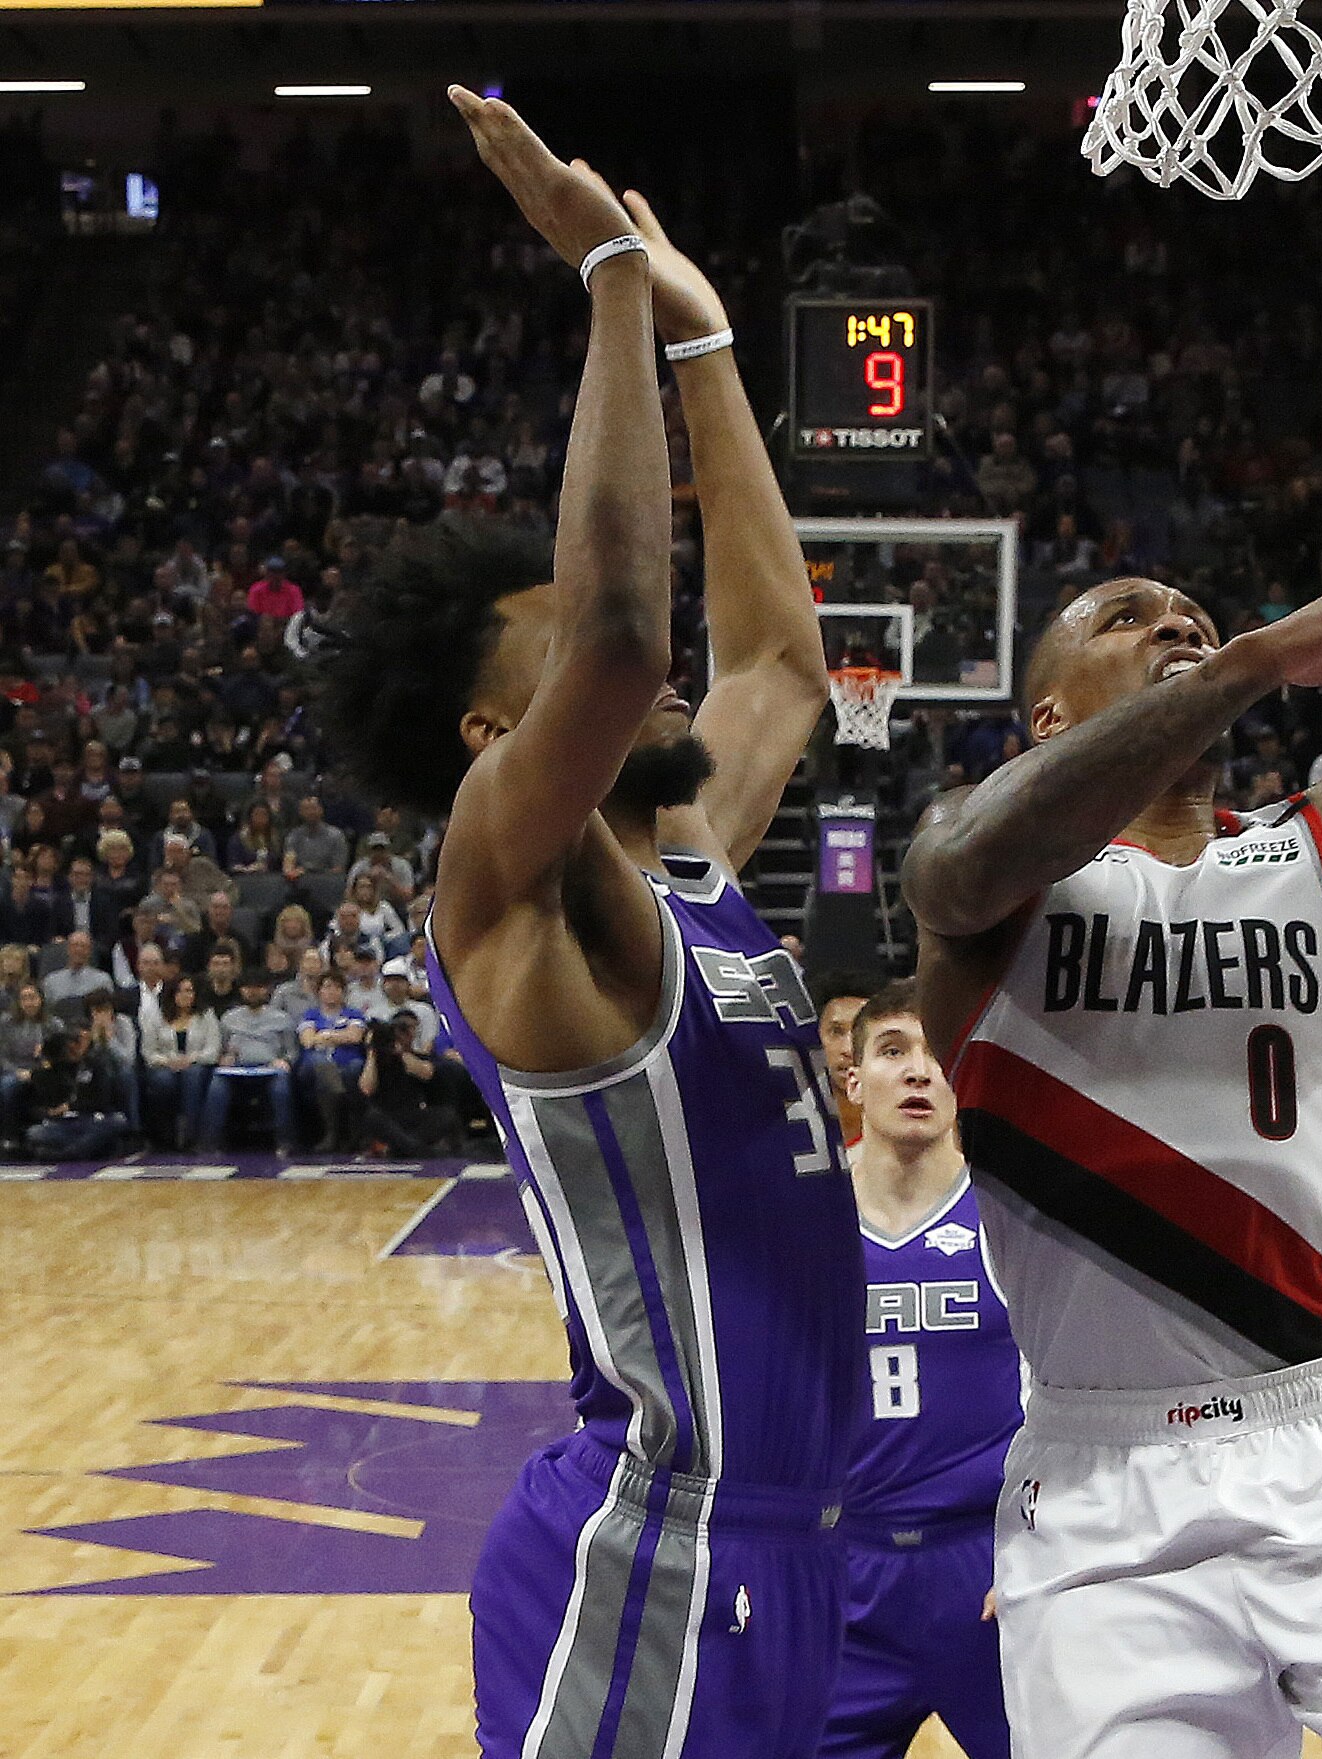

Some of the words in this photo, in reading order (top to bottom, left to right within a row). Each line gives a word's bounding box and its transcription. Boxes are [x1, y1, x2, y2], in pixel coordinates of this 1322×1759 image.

[847, 312, 914, 347] 1:47
[864, 351, 905, 417] 9
[832, 428, 923, 447] TISSOT
[690, 946, 817, 1028] SA
[1044, 912, 1320, 1016] BLAZERS
[1247, 1023, 1298, 1142] 0
[866, 1281, 979, 1334] AC
[869, 1344, 921, 1420] 8
[1167, 1396, 1244, 1428] ripcity
